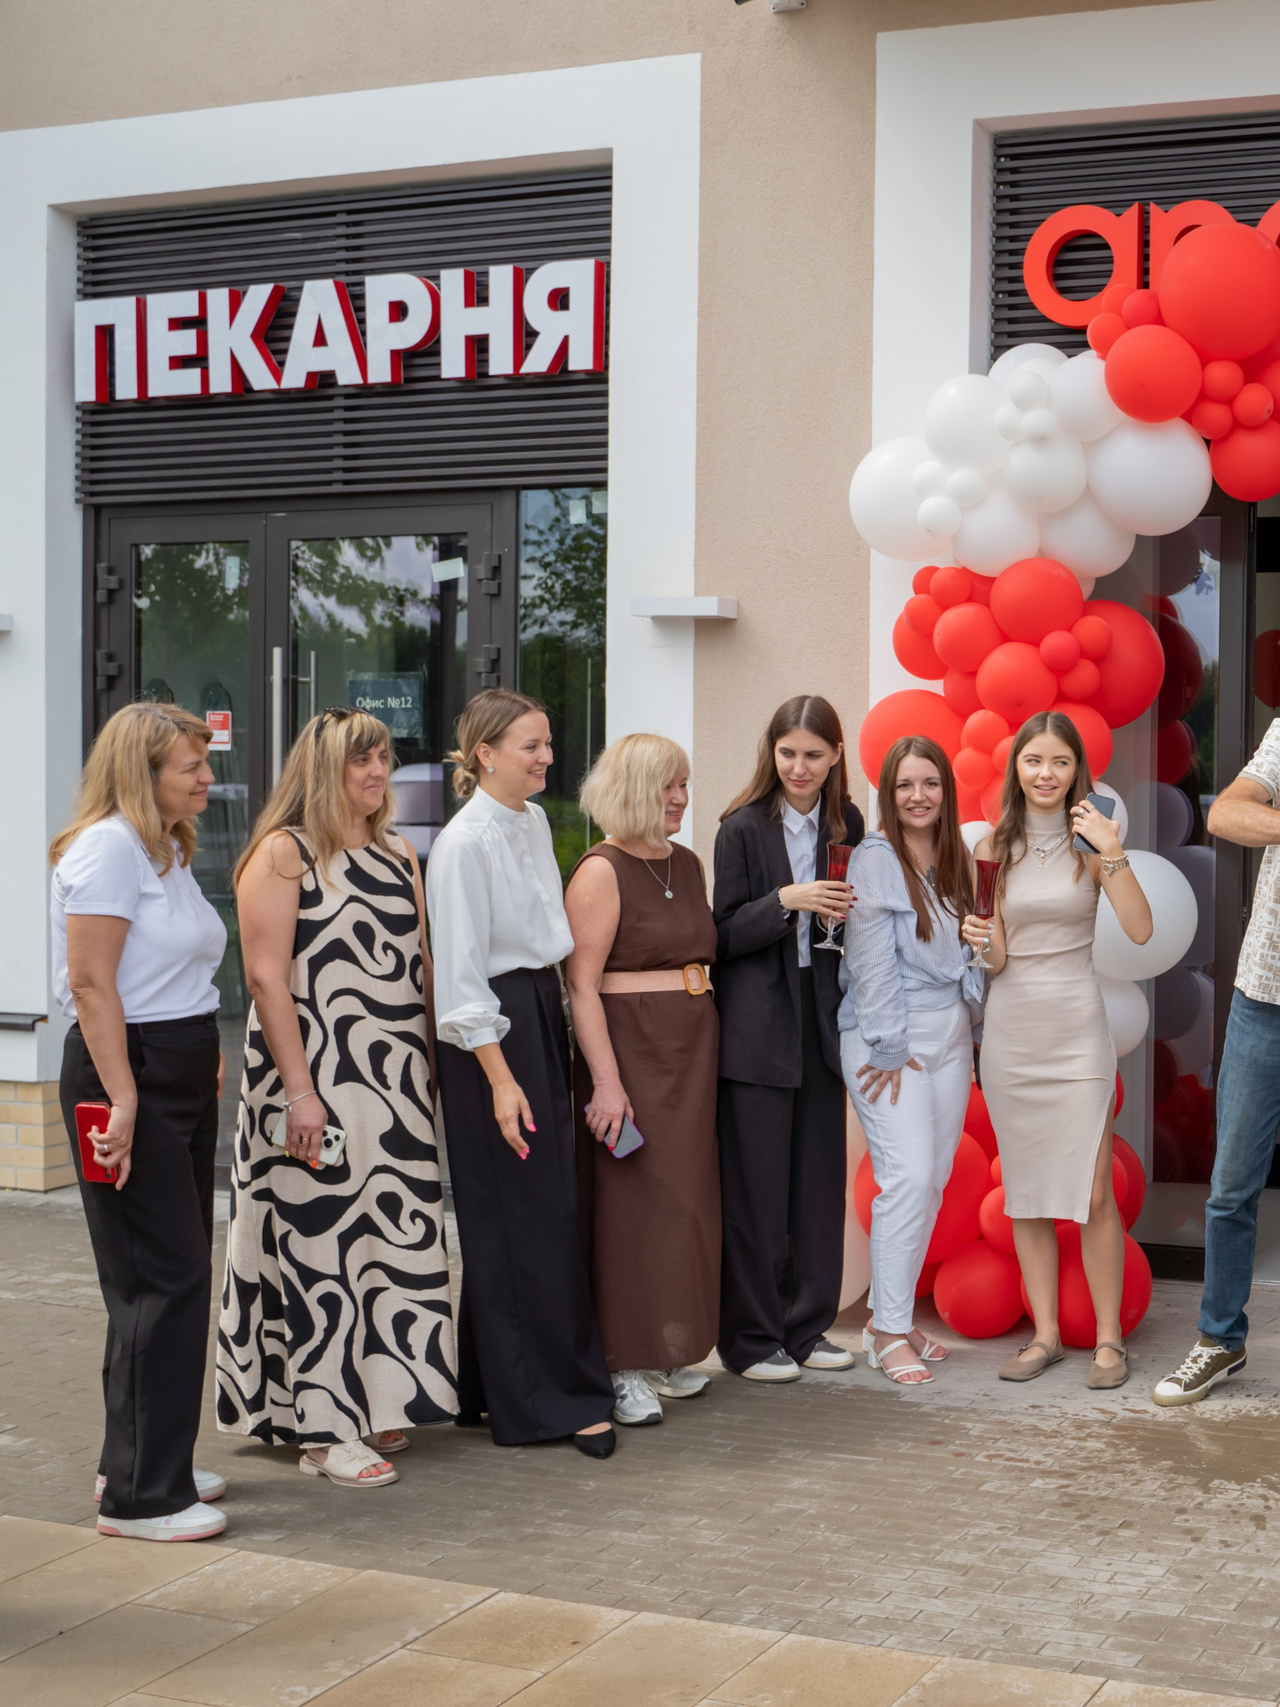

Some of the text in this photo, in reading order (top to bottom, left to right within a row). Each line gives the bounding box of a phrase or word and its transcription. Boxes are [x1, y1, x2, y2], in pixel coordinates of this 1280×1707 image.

[75, 258, 604, 402] ПЕКАРНЯ
[356, 696, 412, 710] Офис №12
